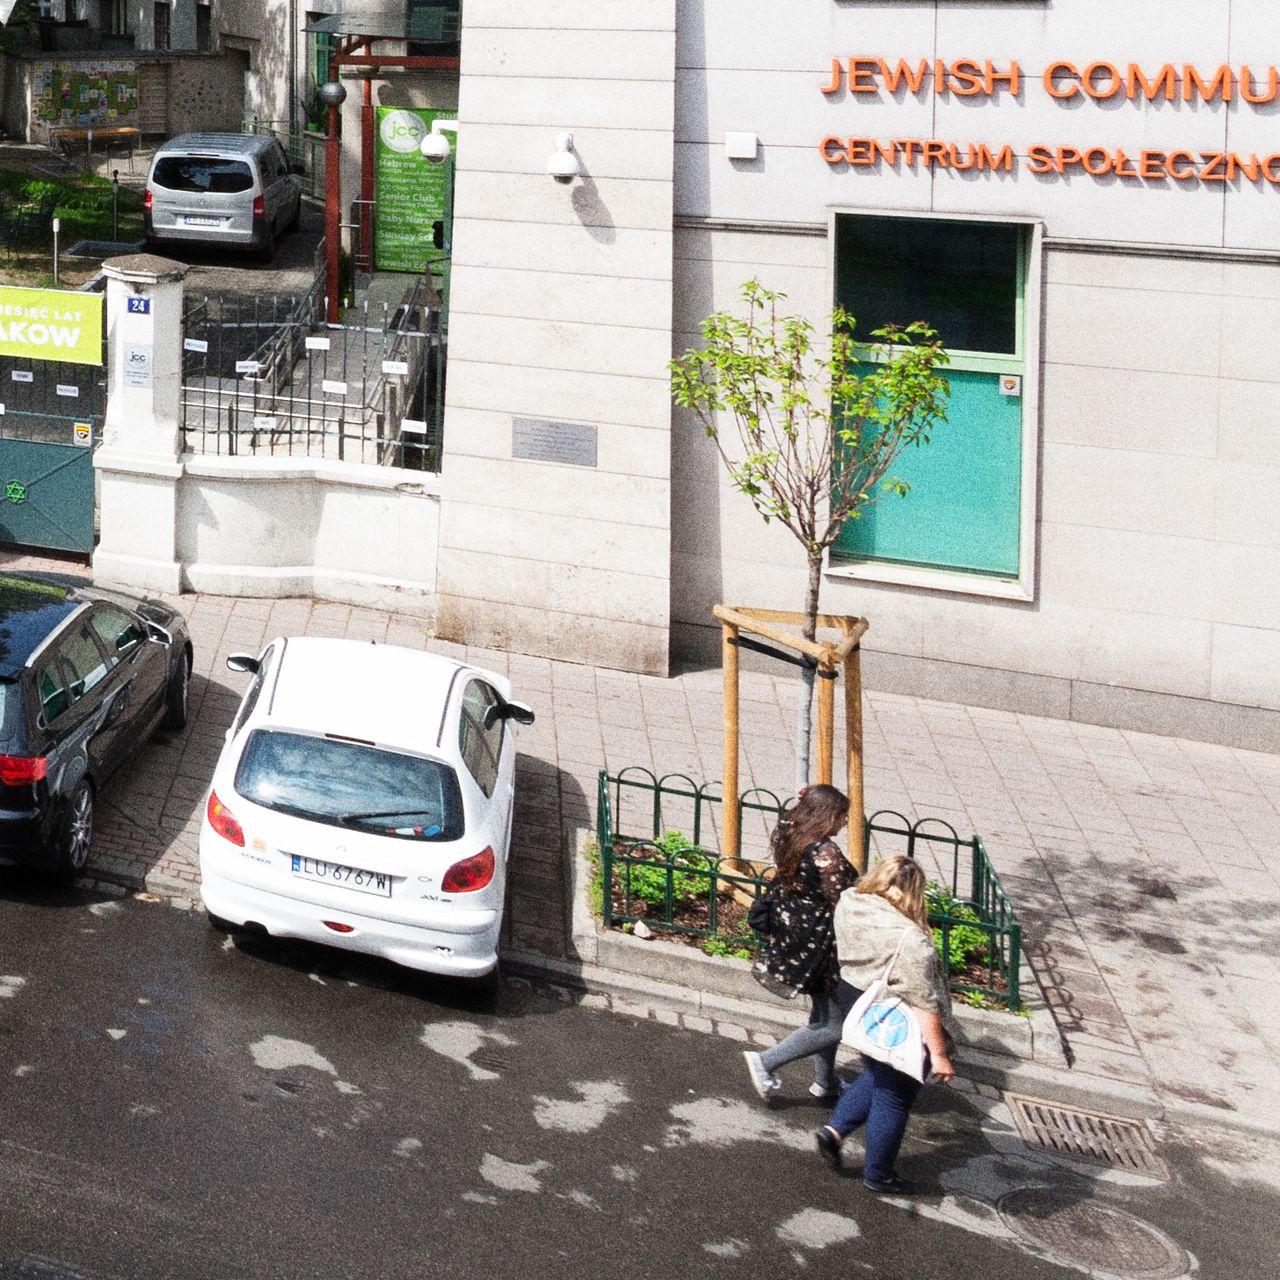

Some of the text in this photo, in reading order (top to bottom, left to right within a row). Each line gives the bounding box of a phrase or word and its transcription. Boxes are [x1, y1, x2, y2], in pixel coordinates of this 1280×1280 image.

[820, 57, 1277, 104] JEWISH COMMU
[819, 136, 1013, 172] CENTRUM
[54, 309, 83, 323] LAT
[132, 299, 145, 312] 24
[304, 857, 386, 890] LU 6767W
